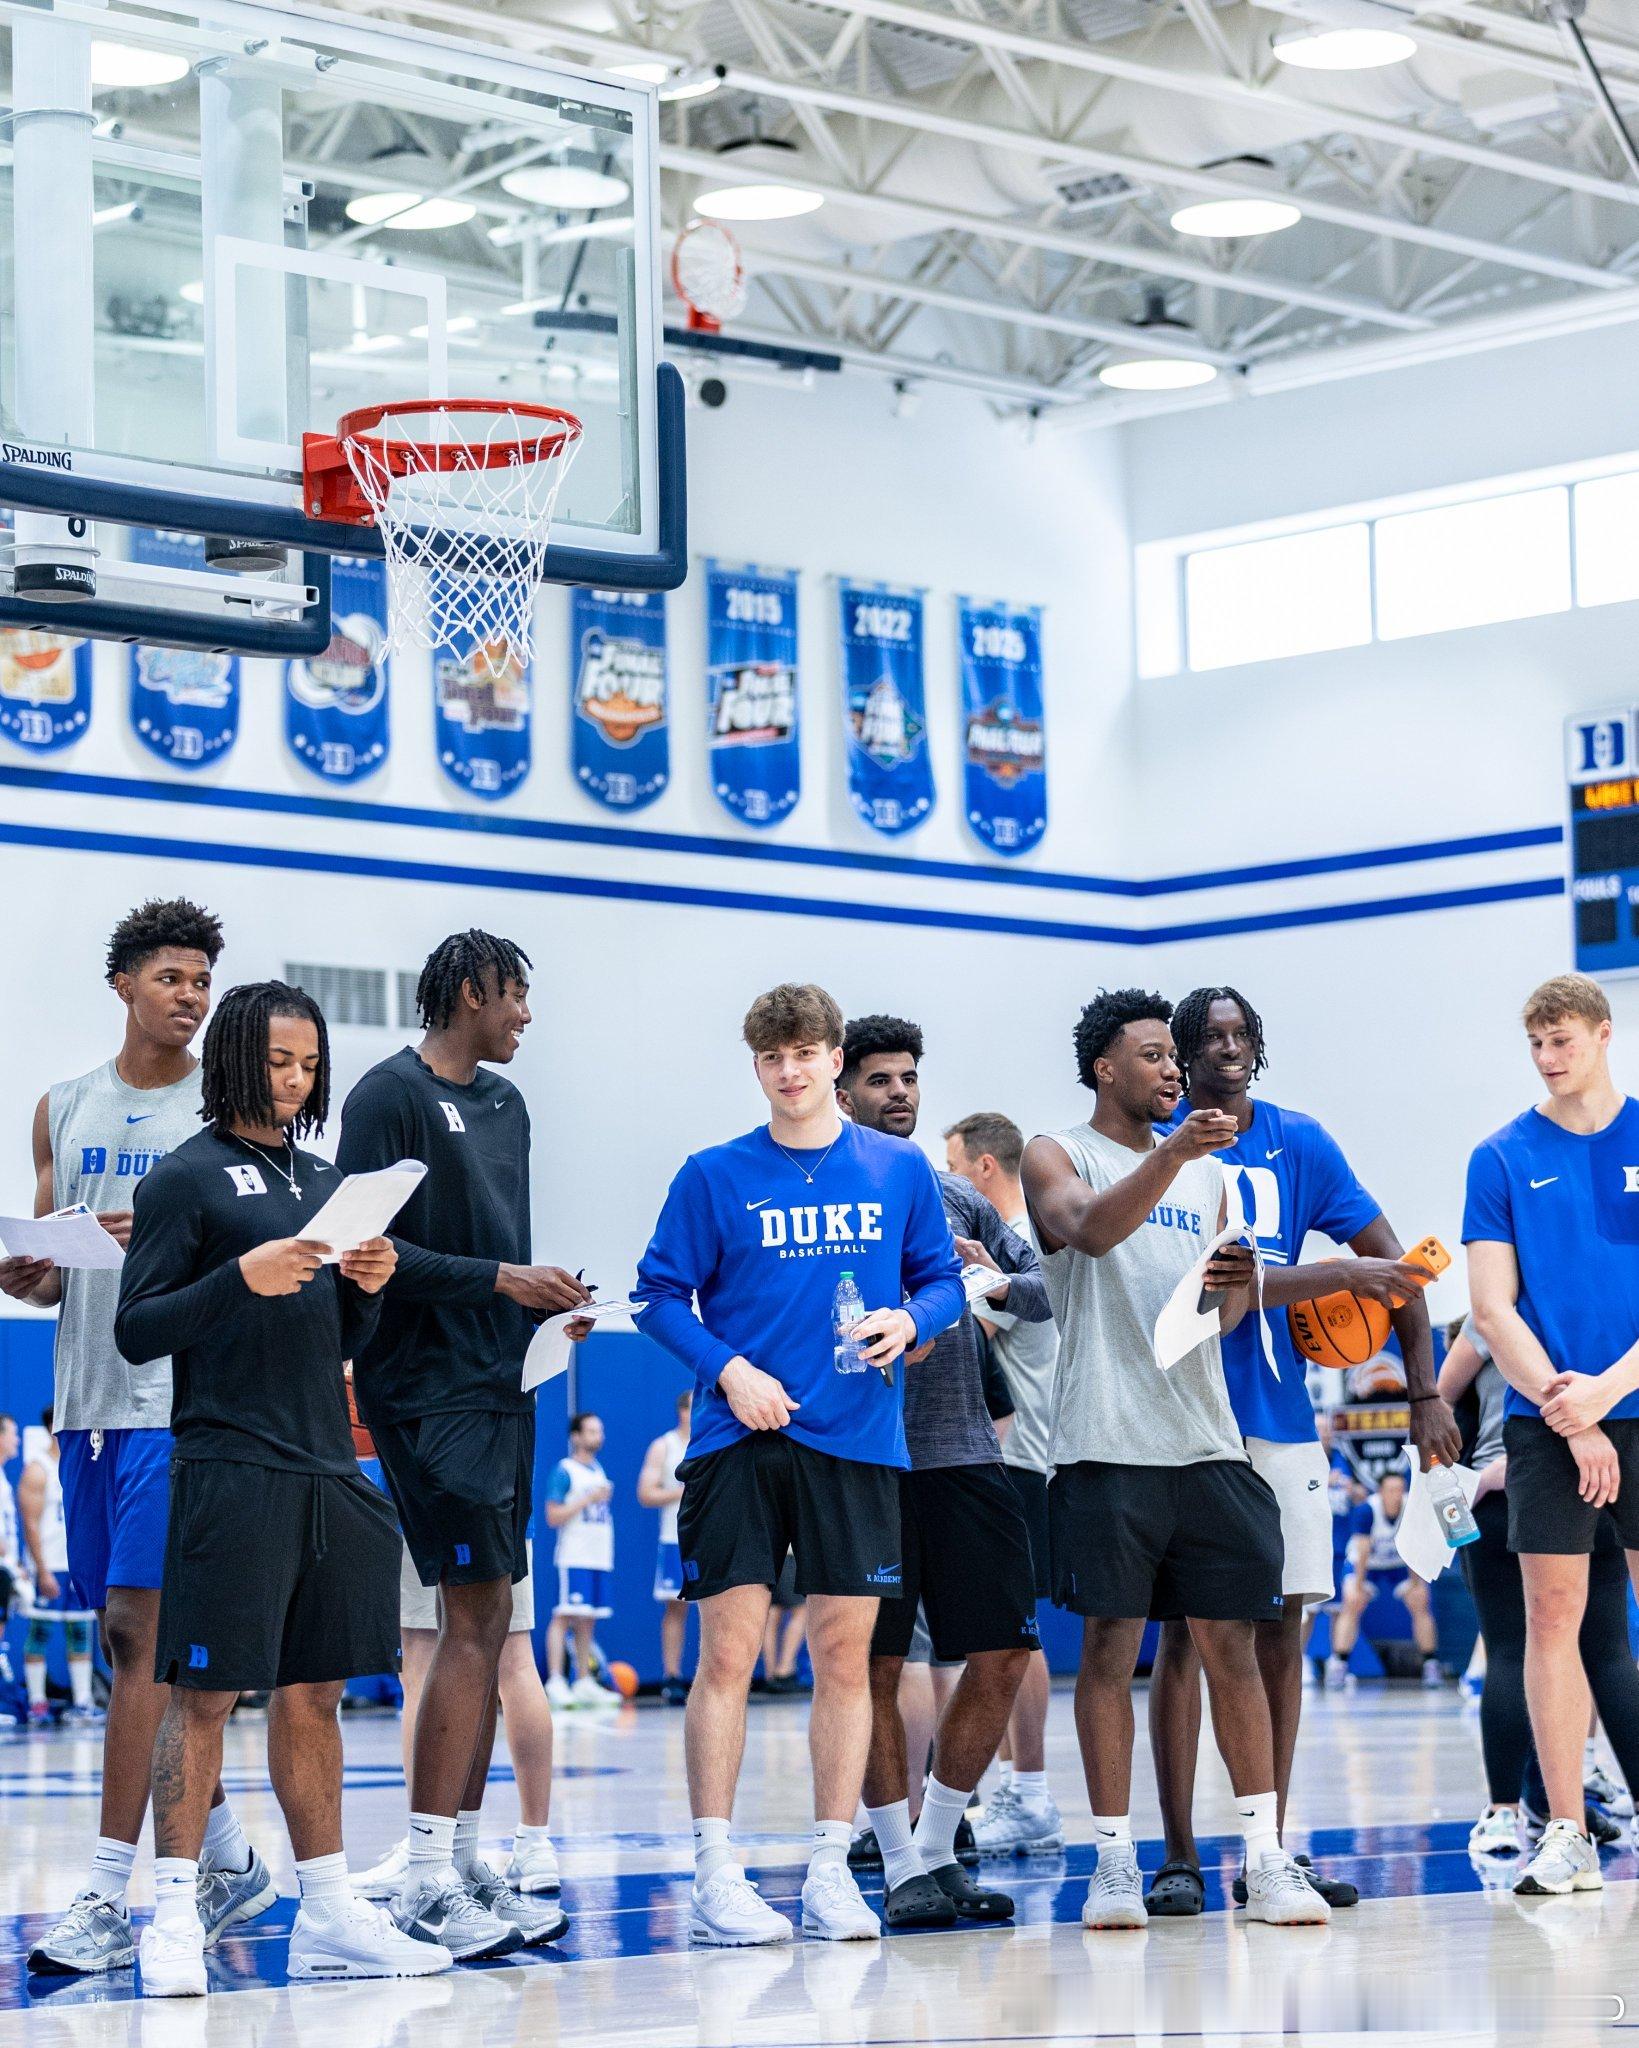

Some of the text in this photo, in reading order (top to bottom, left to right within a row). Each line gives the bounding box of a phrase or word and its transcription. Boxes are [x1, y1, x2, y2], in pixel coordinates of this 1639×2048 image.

[2, 443, 72, 471] SPALDING
[726, 587, 783, 626] 2015
[854, 604, 912, 642] 2022
[115, 1153, 161, 1177] DU
[759, 1202, 883, 1248] DUKE
[779, 1244, 867, 1259] BASKETBALL
